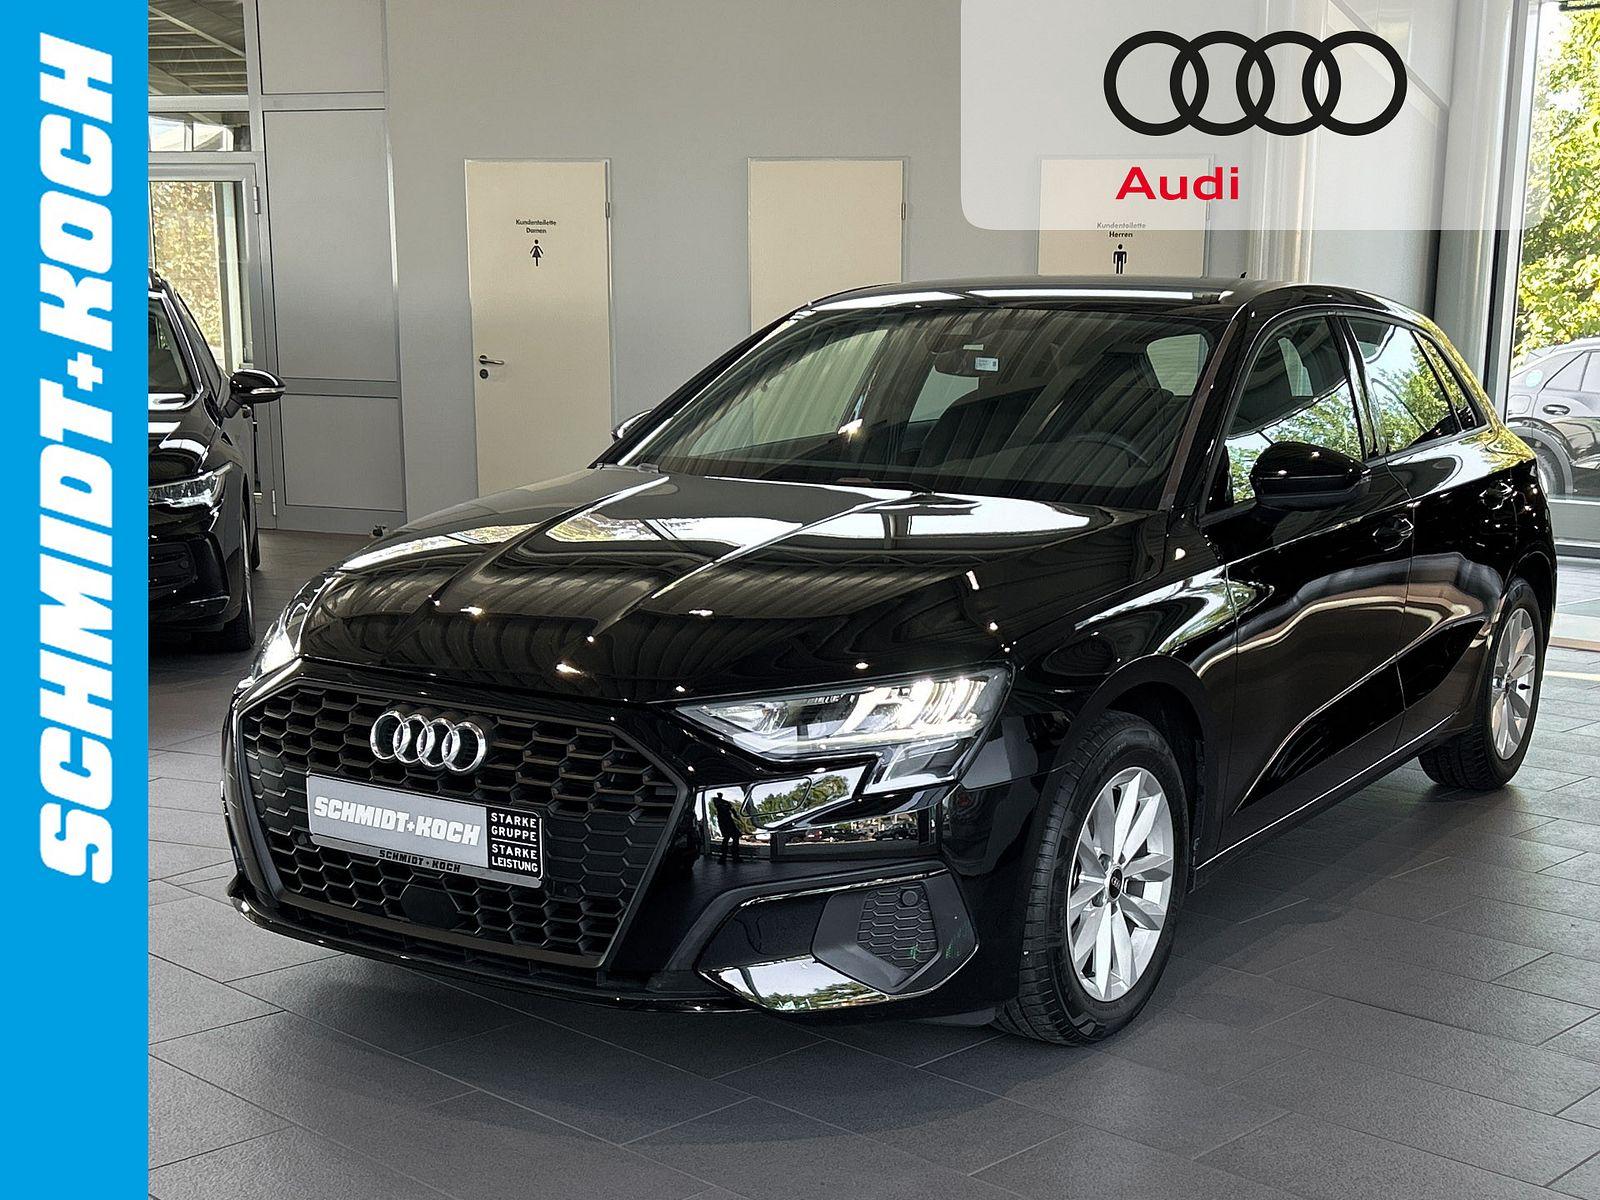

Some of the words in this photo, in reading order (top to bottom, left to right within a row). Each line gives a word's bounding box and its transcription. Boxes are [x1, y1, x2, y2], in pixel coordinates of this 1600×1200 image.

[1109, 230, 1133, 238] Herren
[313, 796, 482, 847] SCHMIDT+KOCH
[490, 812, 537, 829] STARKE
[491, 825, 538, 842] GRUPPE
[491, 843, 538, 860] STARKE
[379, 849, 424, 866] SCHMIDT
[431, 859, 461, 873] KOCH
[491, 855, 539, 873] LEISTUNG
